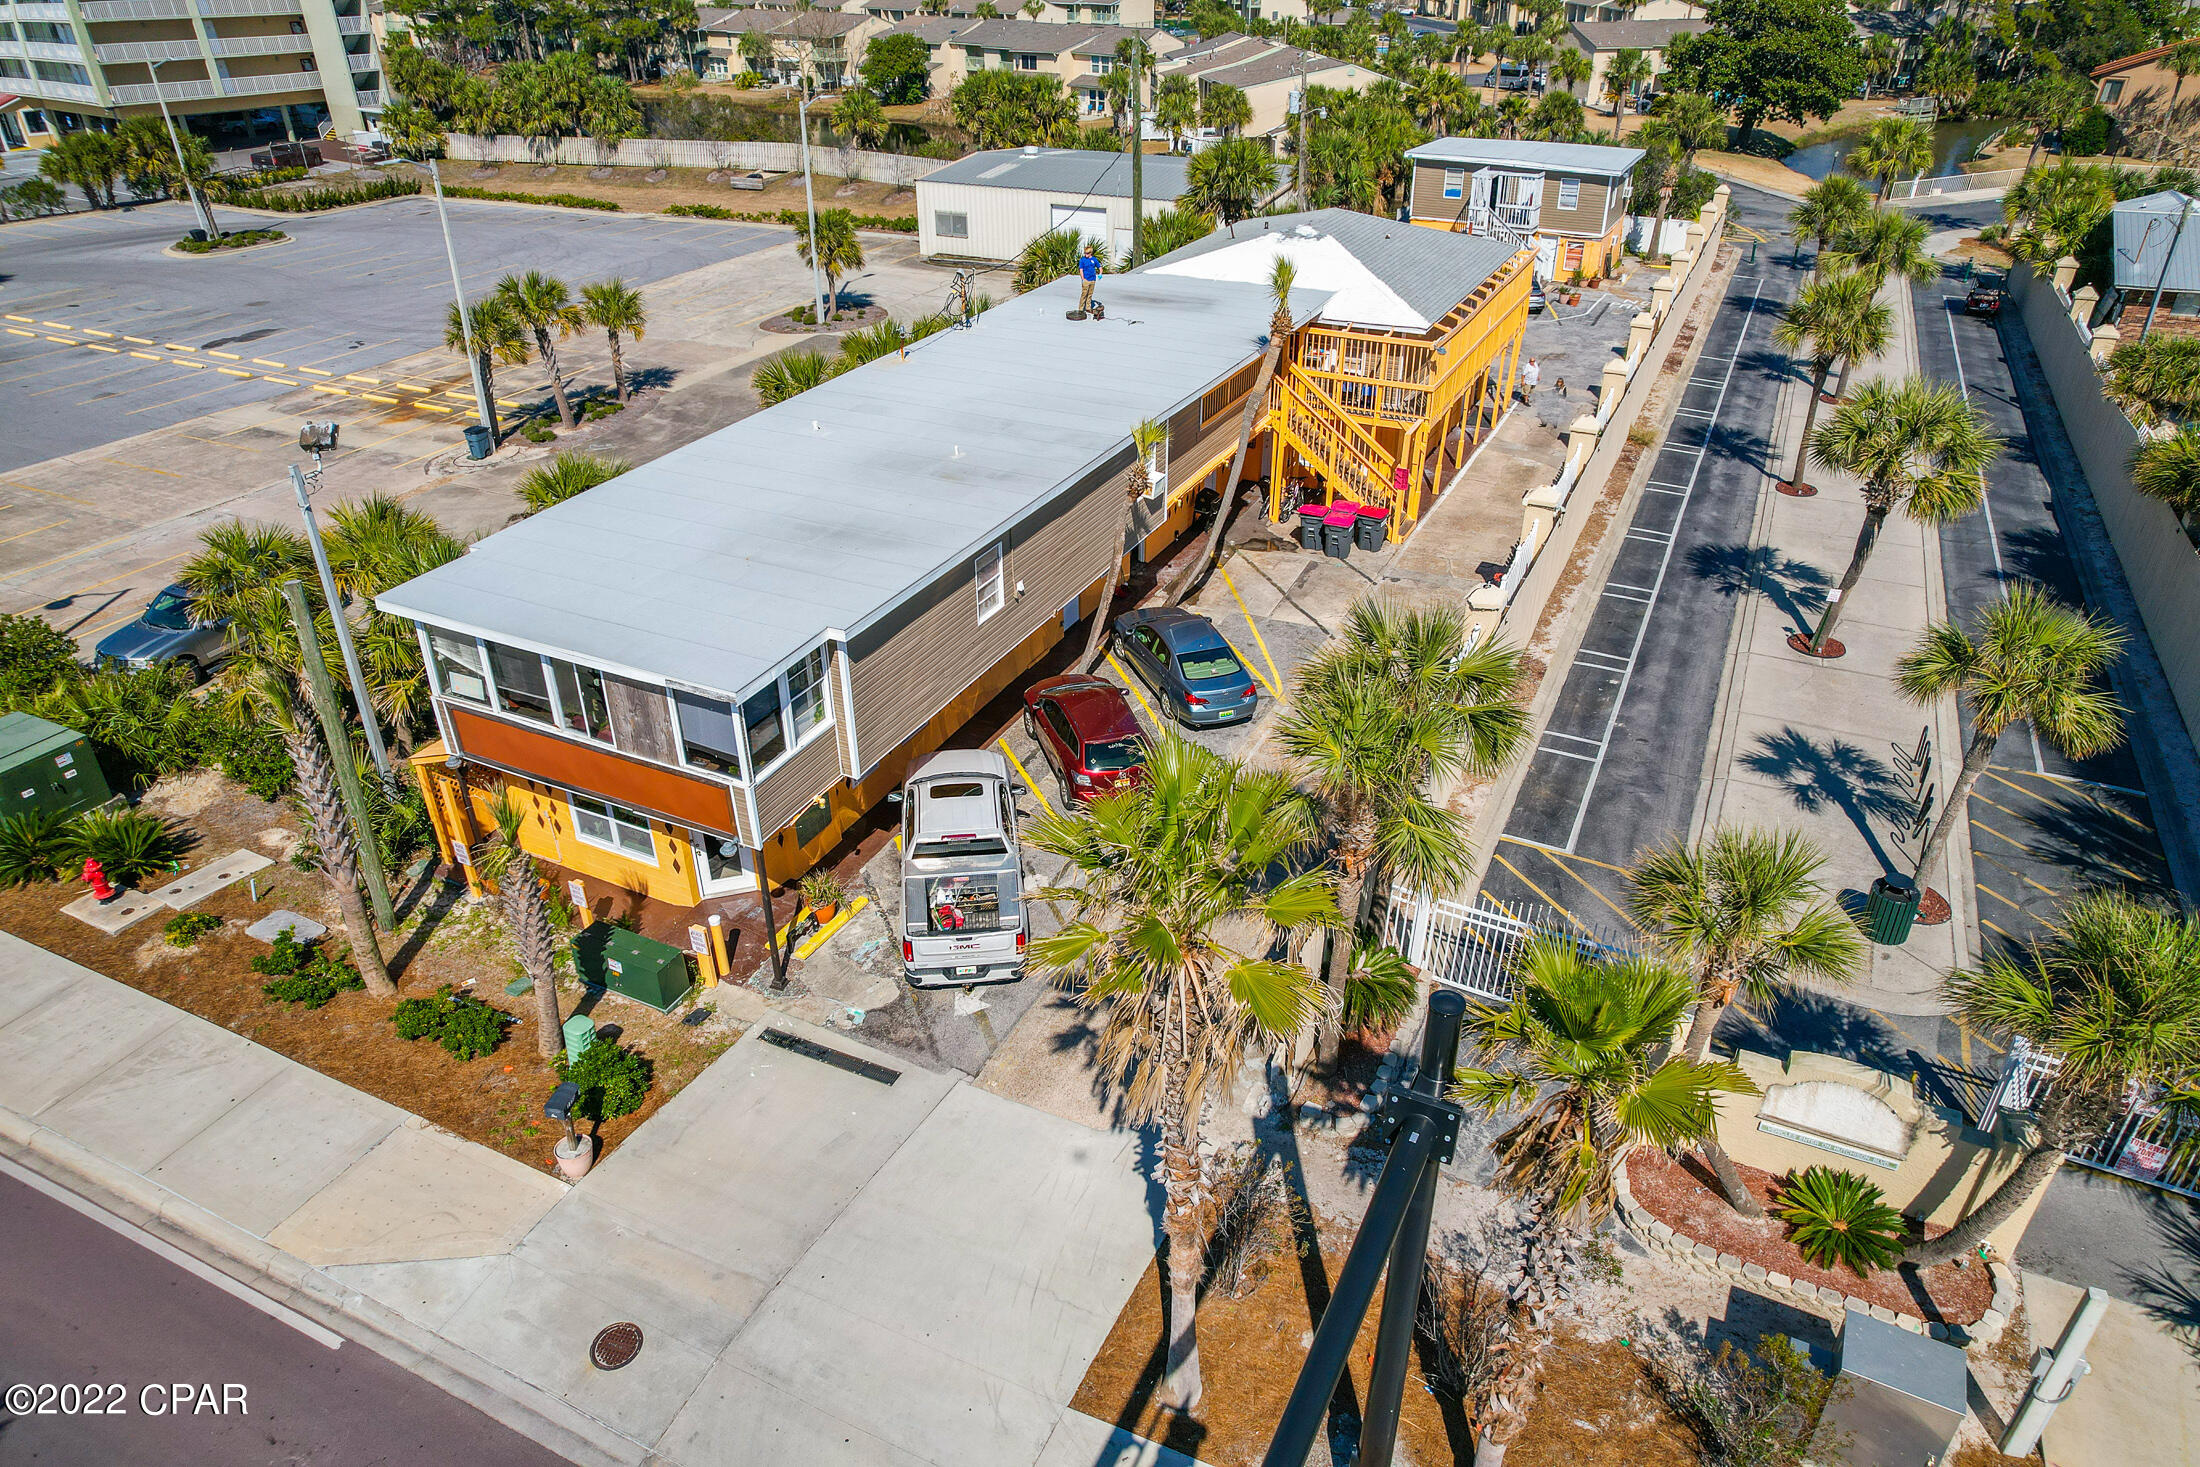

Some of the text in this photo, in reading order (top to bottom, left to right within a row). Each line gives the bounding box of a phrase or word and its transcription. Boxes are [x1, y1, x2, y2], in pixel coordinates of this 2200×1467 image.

[2130, 1138, 2170, 1155] TOW AWAY
[2136, 1147, 2156, 1158] ZONE
